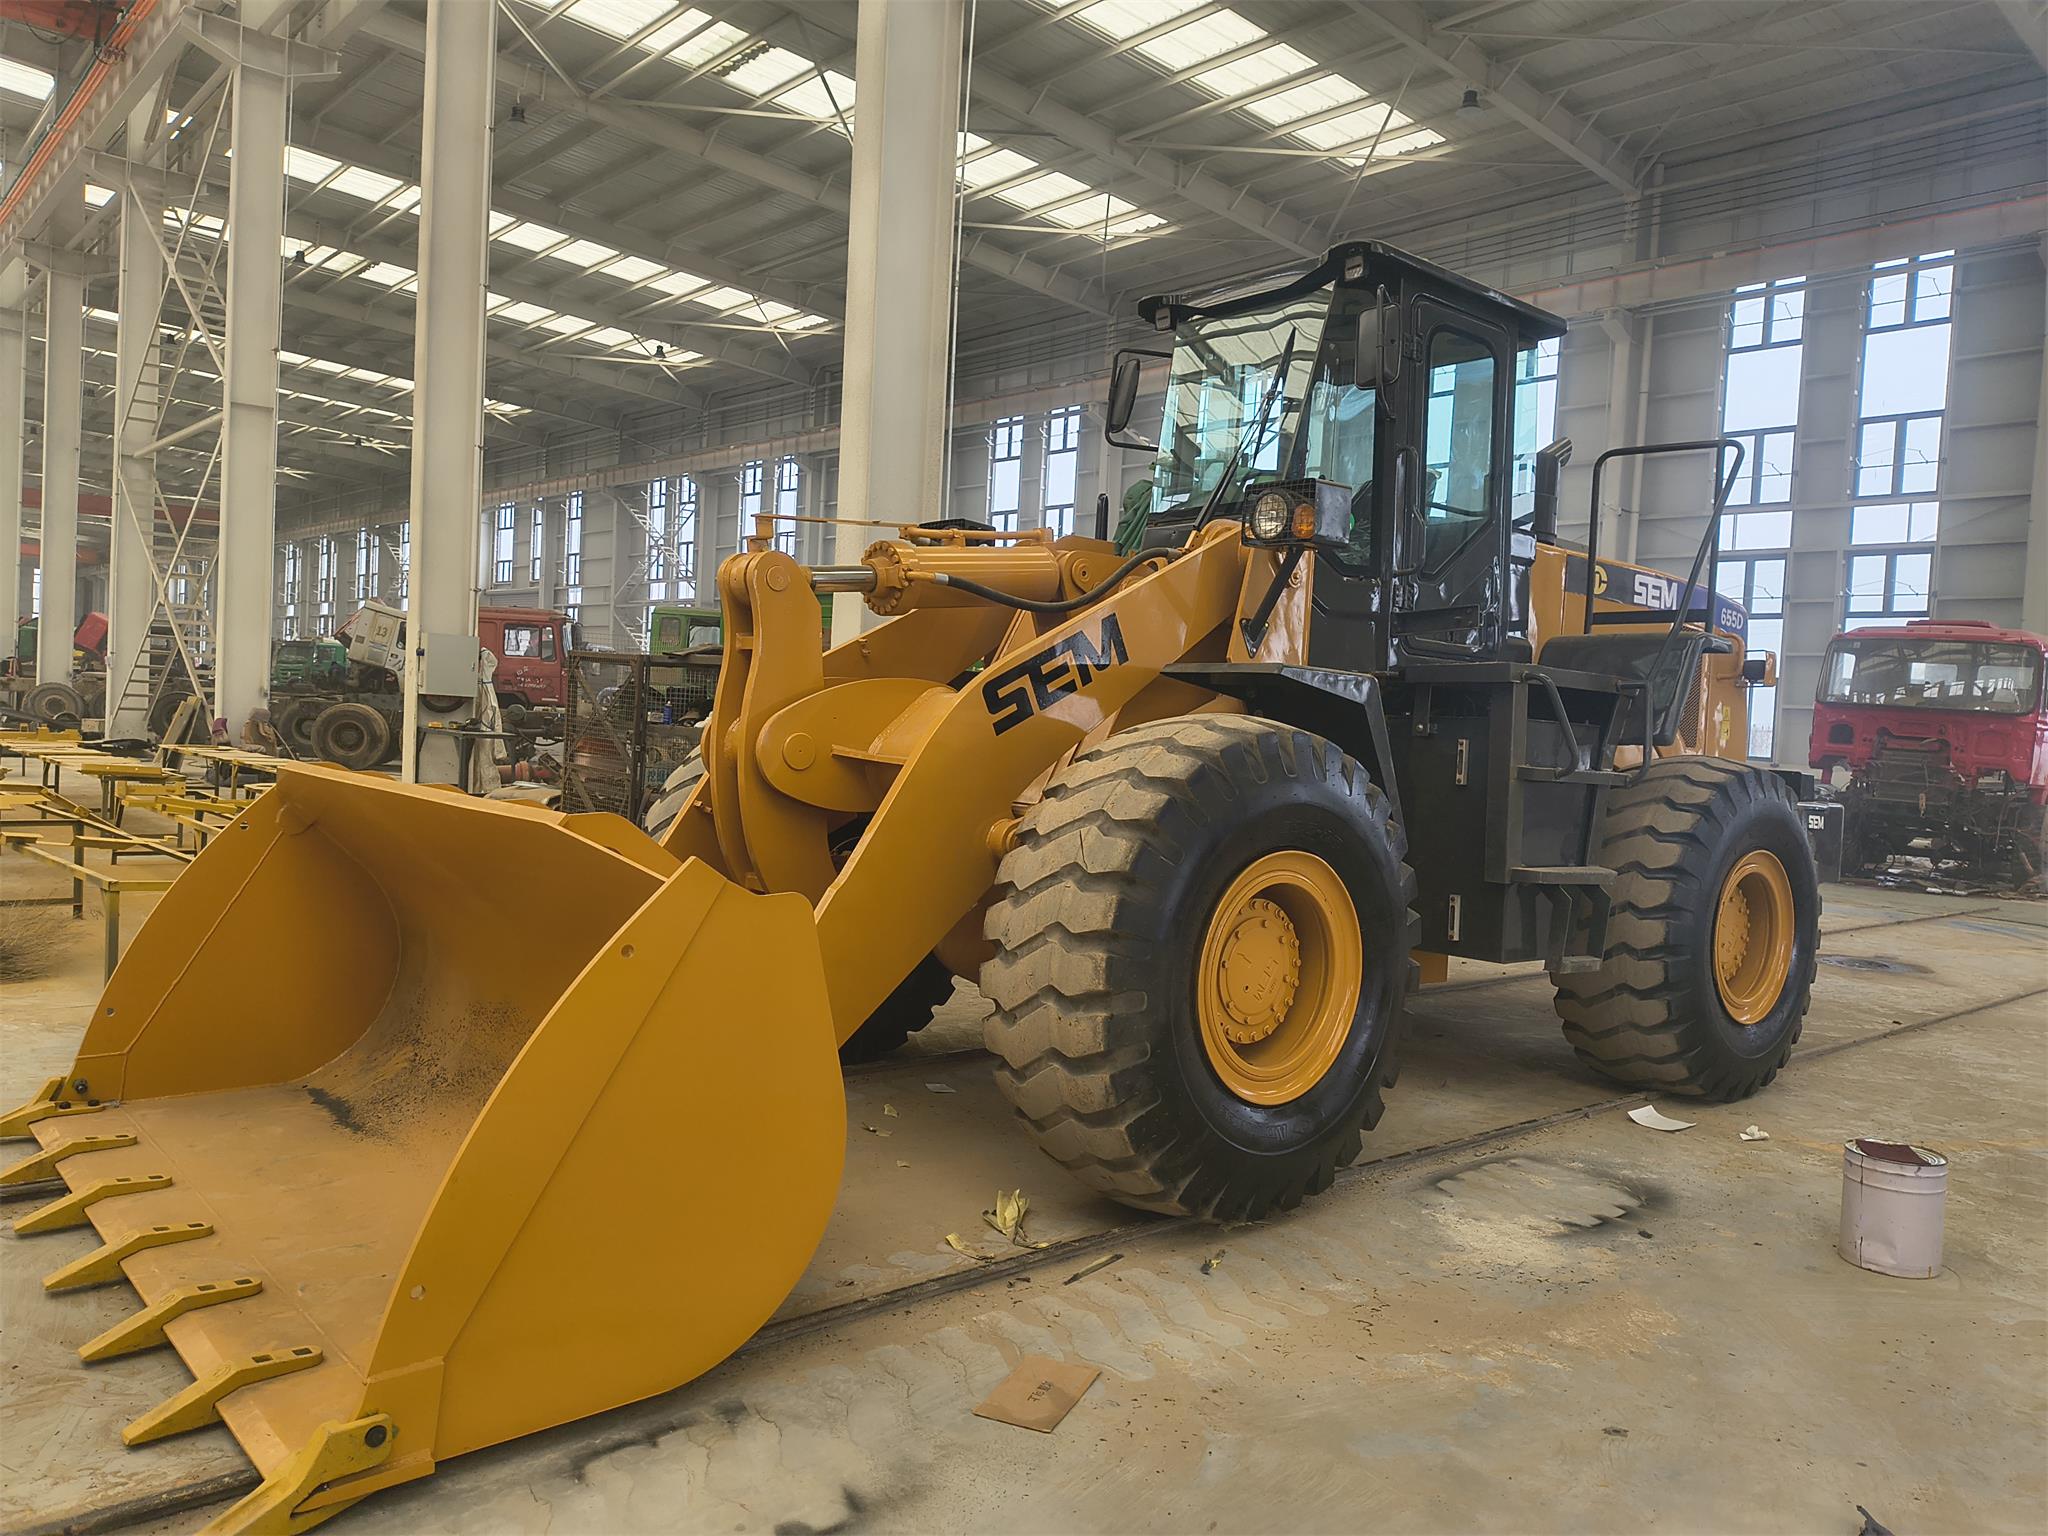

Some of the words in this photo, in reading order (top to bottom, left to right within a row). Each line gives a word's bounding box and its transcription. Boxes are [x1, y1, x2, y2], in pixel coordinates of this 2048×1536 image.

[1633, 574, 1678, 610] SEM
[1721, 607, 1744, 630] 655D
[982, 613, 1129, 736] SEM
[1808, 815, 1824, 830] SEM
